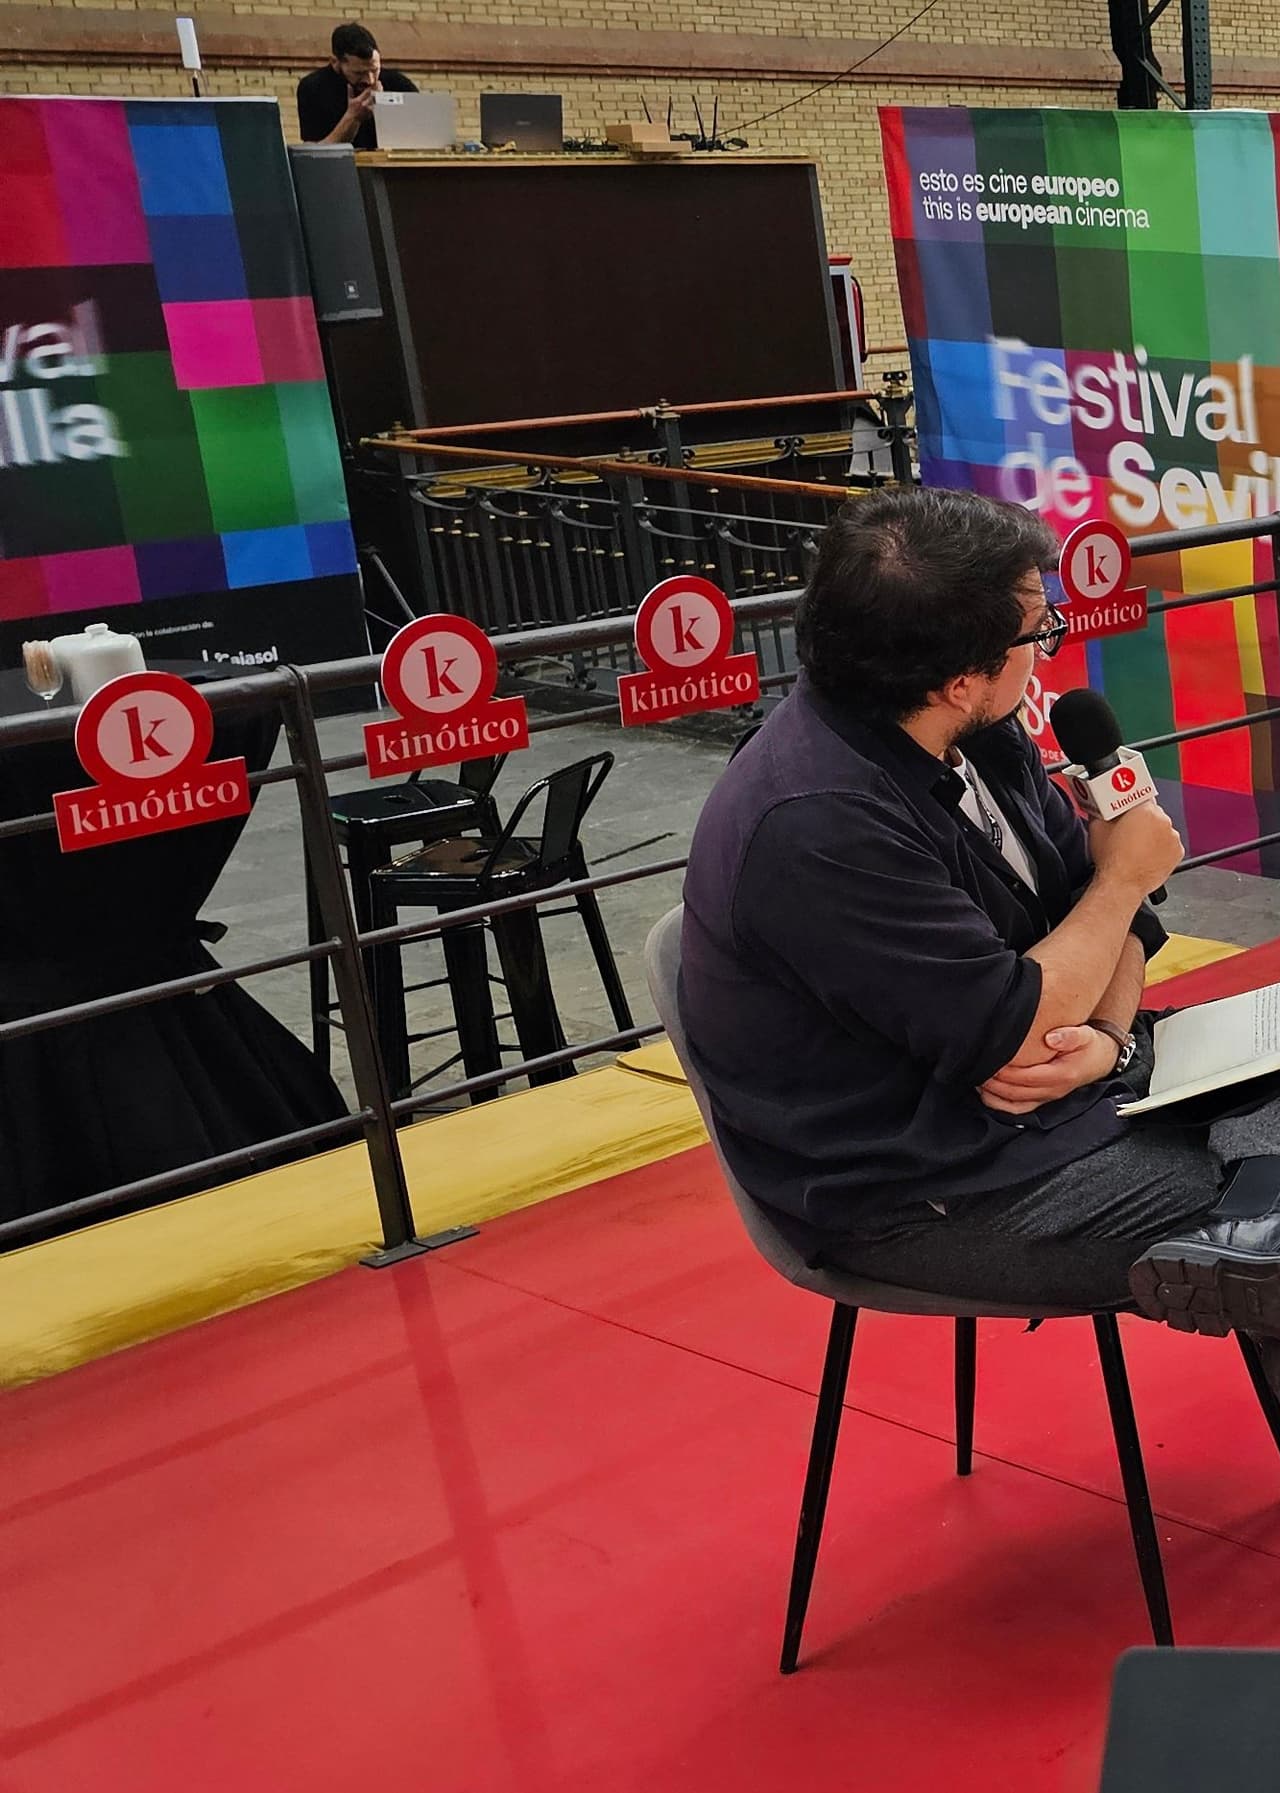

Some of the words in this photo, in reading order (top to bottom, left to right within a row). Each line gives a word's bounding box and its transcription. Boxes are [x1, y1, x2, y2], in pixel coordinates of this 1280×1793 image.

[919, 168, 958, 192] esto
[963, 173, 985, 193] es
[989, 168, 1028, 194] cine
[1031, 176, 1120, 203] europeo
[923, 196, 953, 220] this
[957, 196, 971, 221] is
[976, 202, 1073, 229] european
[1075, 201, 1150, 228] cinema
[985, 335, 1260, 444] Festival
[997, 431, 1093, 519] de
[1084, 545, 1110, 588] k
[668, 605, 705, 655] k
[1068, 601, 1142, 635] inótico
[420, 645, 463, 700] k
[629, 671, 753, 714] kinótico
[121, 705, 173, 766] k
[376, 715, 520, 764] kinótico
[70, 780, 240, 835] kinótico
[1110, 785, 1152, 812] kinótico
